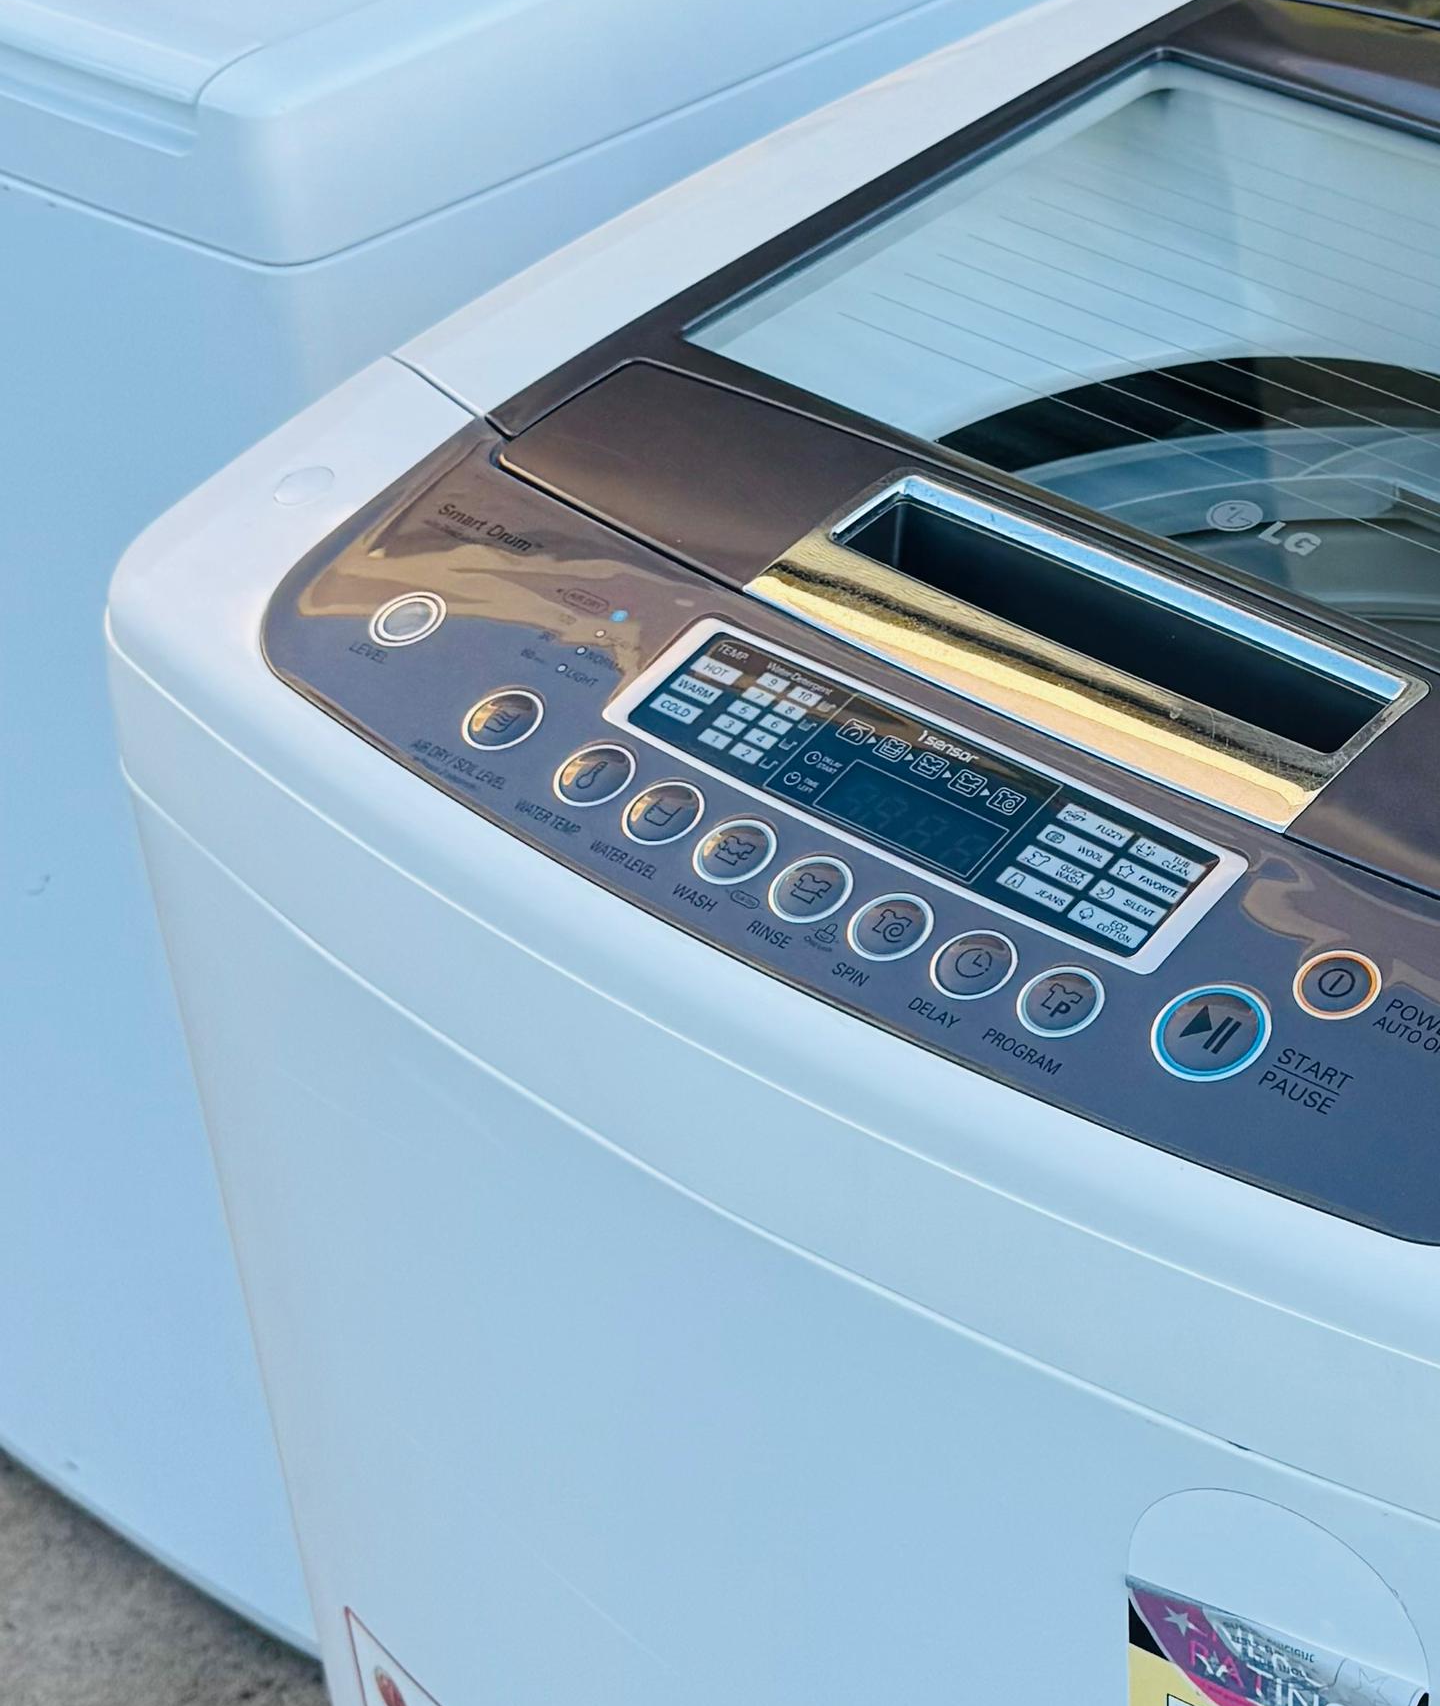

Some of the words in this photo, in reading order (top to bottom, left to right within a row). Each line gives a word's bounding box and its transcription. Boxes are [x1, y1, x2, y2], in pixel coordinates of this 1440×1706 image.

[438, 503, 487, 531] Smart
[1258, 521, 1322, 556] LG
[349, 642, 388, 664] LEVEL
[565, 670, 599, 688] LIGHT
[703, 662, 728, 678] HOT
[678, 678, 716, 701] WARM
[798, 691, 813, 702] 10
[660, 700, 691, 718] COLD
[453, 757, 477, 776] SOIL
[475, 768, 506, 790] LEVEL
[514, 798, 552, 825] WATER
[550, 814, 582, 837] TEMP
[1096, 824, 1125, 840] FUZZY
[590, 839, 628, 866] WATER
[624, 854, 658, 881] LEVEL
[1078, 846, 1103, 862] WOOL
[1172, 856, 1192, 868] TUB
[1055, 870, 1082, 886] WASH
[1060, 863, 1087, 880] QUICK
[1161, 860, 1190, 877] CLEAN
[672, 883, 717, 913] WASH
[1035, 889, 1065, 907] JEANS
[1138, 875, 1178, 899] FAVORITE
[1122, 899, 1155, 918] SILENT
[746, 920, 792, 949] RINSE
[1096, 923, 1132, 944] COTTON
[1109, 920, 1128, 932] ECO
[832, 962, 870, 988] SPIN
[907, 997, 961, 1029] DELAY
[1372, 1017, 1420, 1044] AUTO
[982, 1028, 1063, 1076] PROGRAM
[1277, 1048, 1354, 1090] START
[1258, 1070, 1336, 1115] PAUSE
